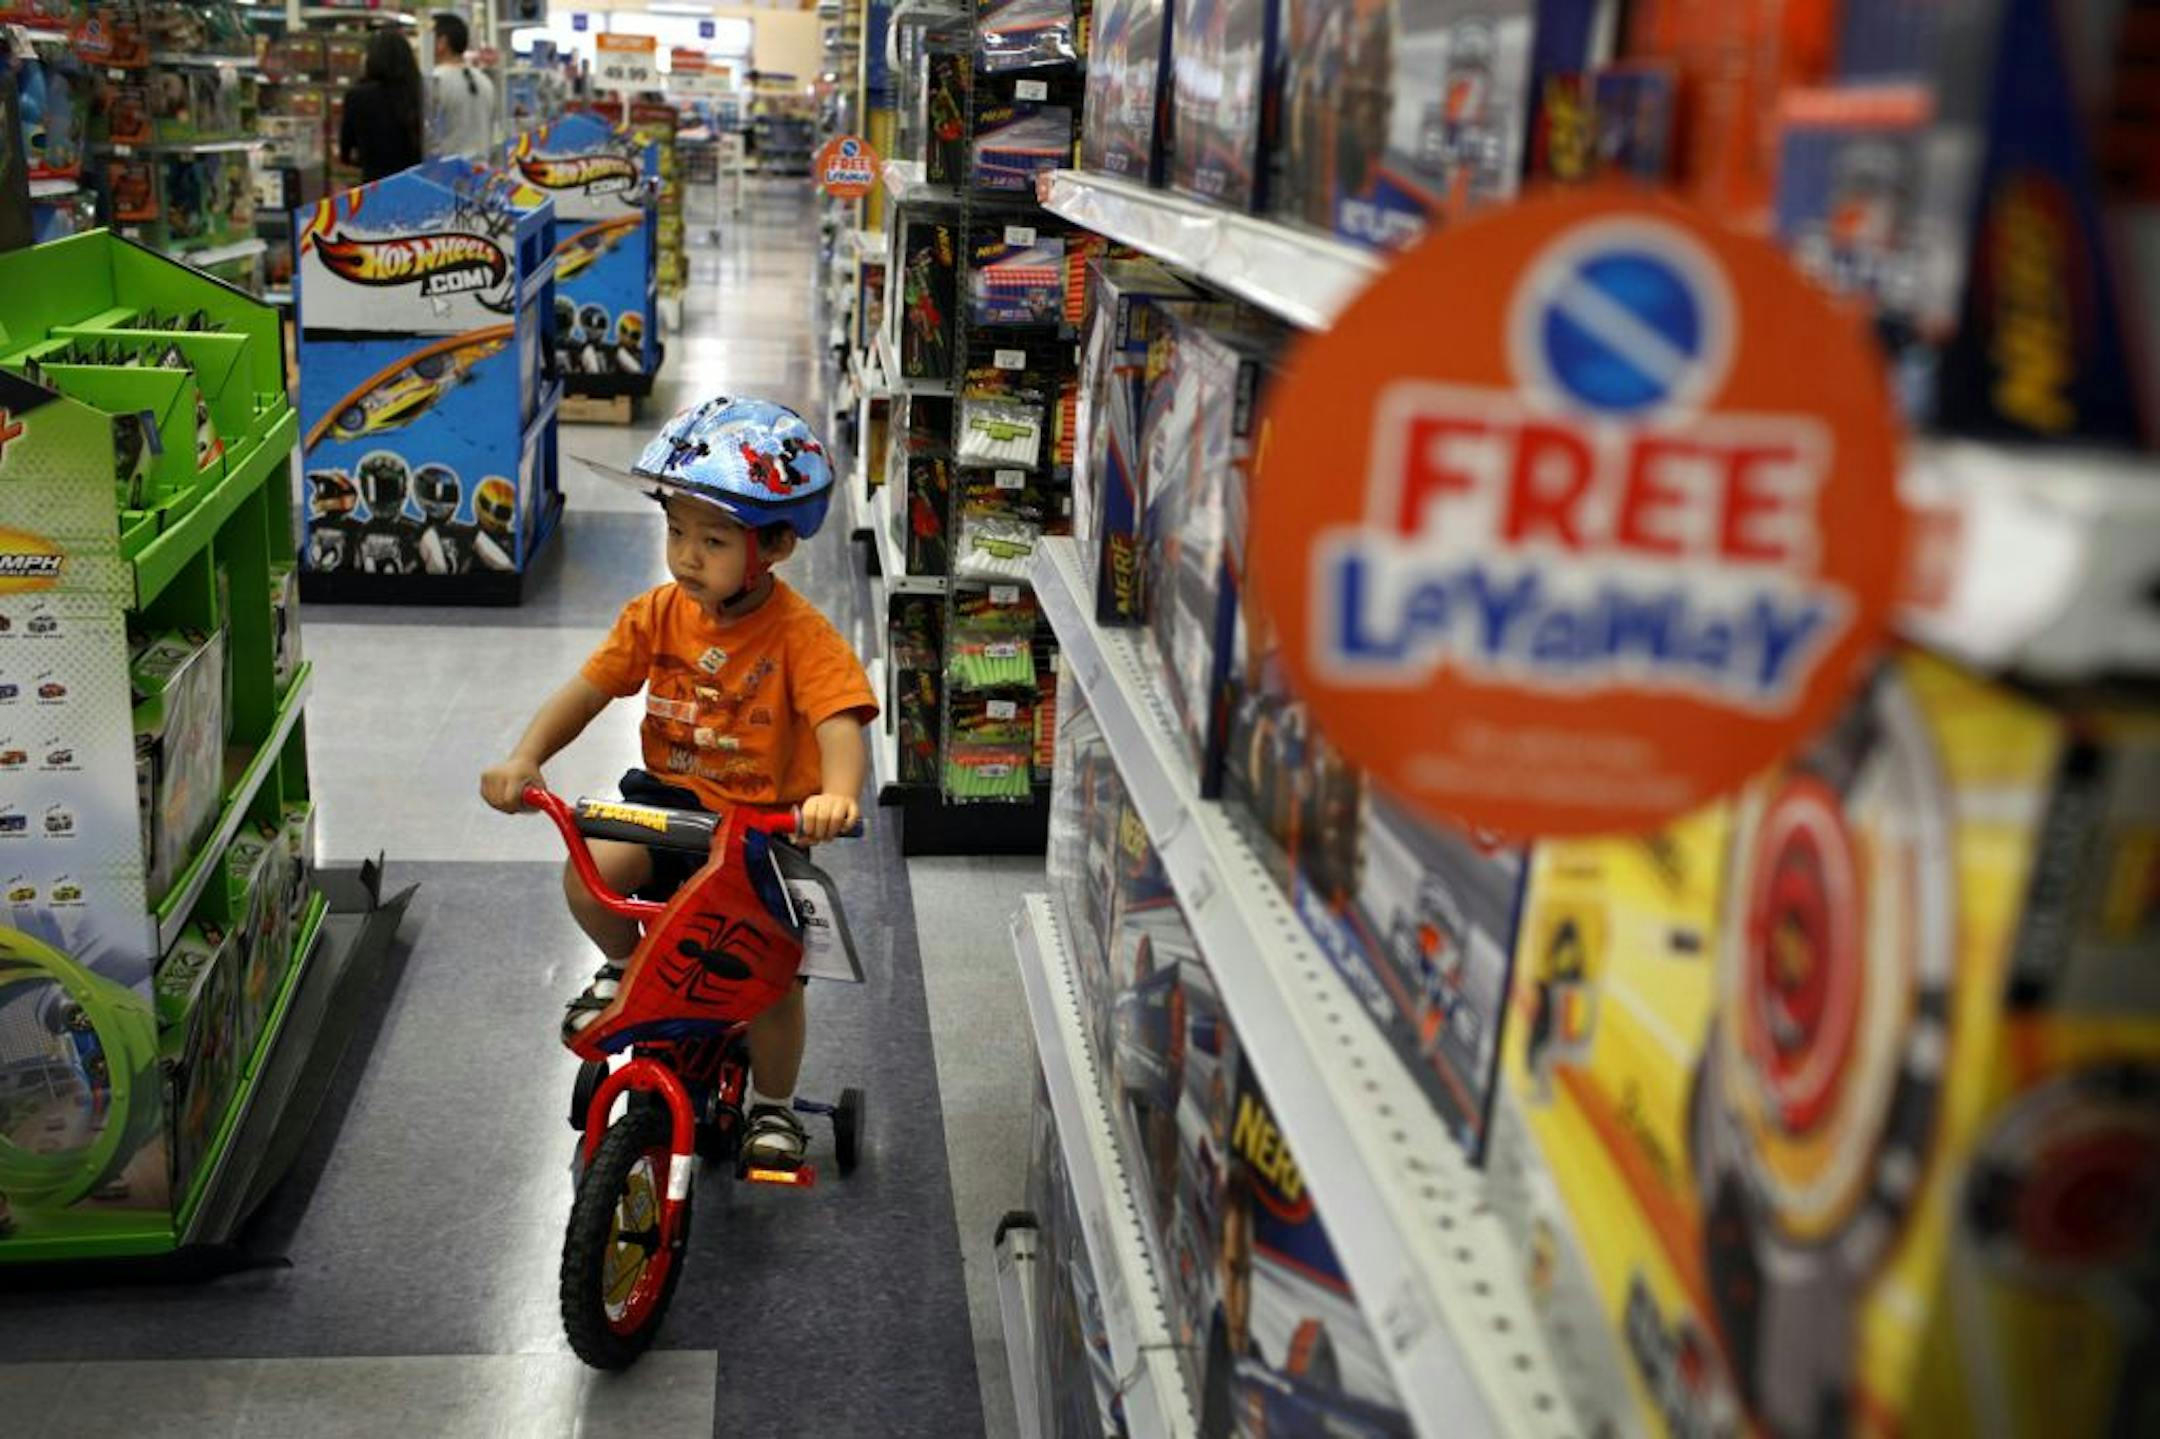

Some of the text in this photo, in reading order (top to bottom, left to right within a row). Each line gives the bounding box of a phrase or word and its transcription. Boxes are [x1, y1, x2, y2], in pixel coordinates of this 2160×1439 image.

[371, 243, 414, 279] HOT
[1399, 413, 1799, 563] FREE
[0, 555, 62, 568] MPH
[1111, 533, 1133, 614] NERF
